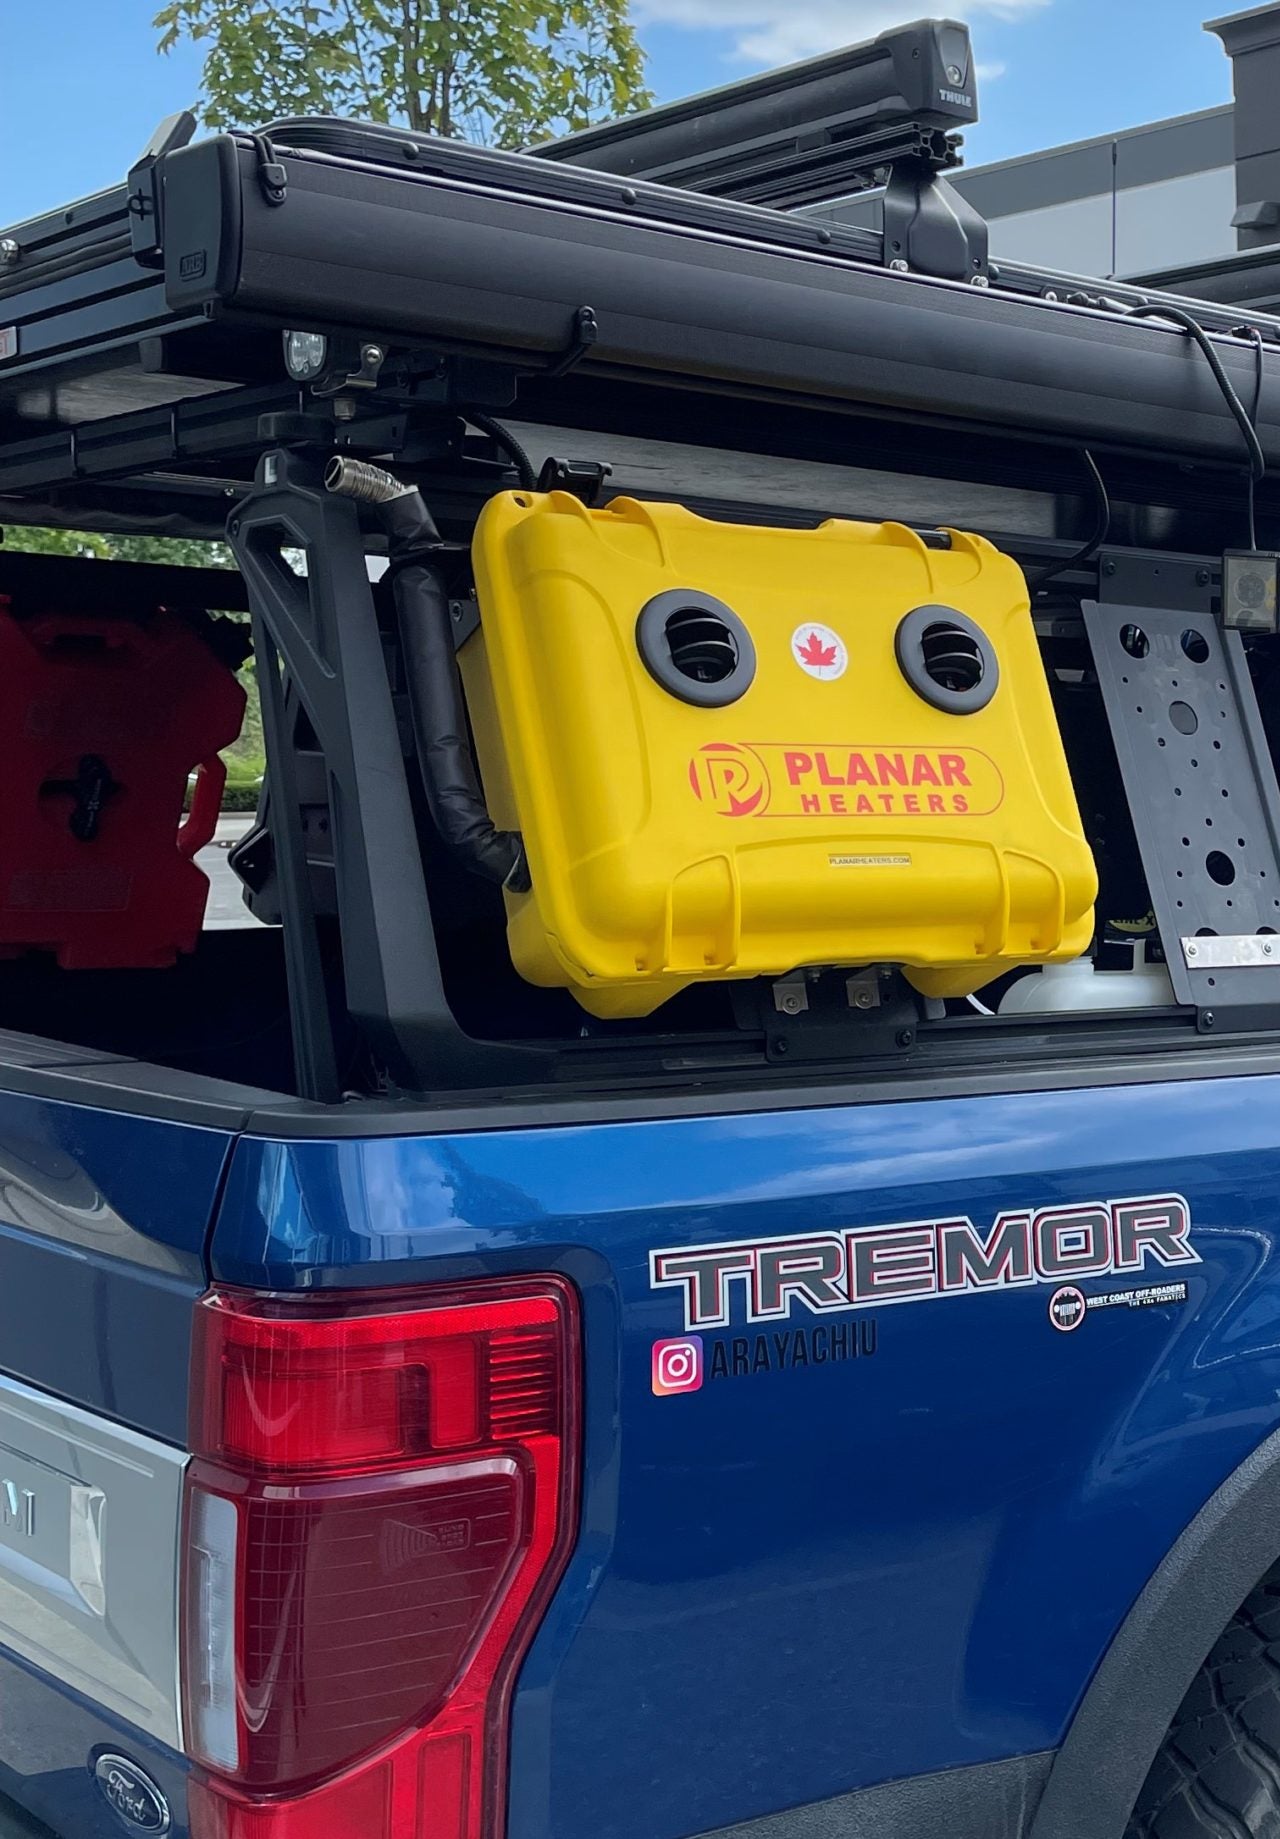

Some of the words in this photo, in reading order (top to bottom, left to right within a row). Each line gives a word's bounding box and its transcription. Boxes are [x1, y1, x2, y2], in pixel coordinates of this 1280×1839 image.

[939, 88, 972, 108] THULE
[784, 752, 972, 787] PLANAR
[800, 793, 969, 815] HEATERS
[829, 857, 910, 865] PLANARHEATERS.COM
[649, 1192, 1203, 1332] TREMOR
[1086, 1295, 1108, 1306] WEST
[1109, 1291, 1135, 1303] COAST
[1135, 1284, 1185, 1299] OFF-ROADERS
[710, 1319, 878, 1380] ARAYACHIU
[106, 1769, 147, 1821] Ford
